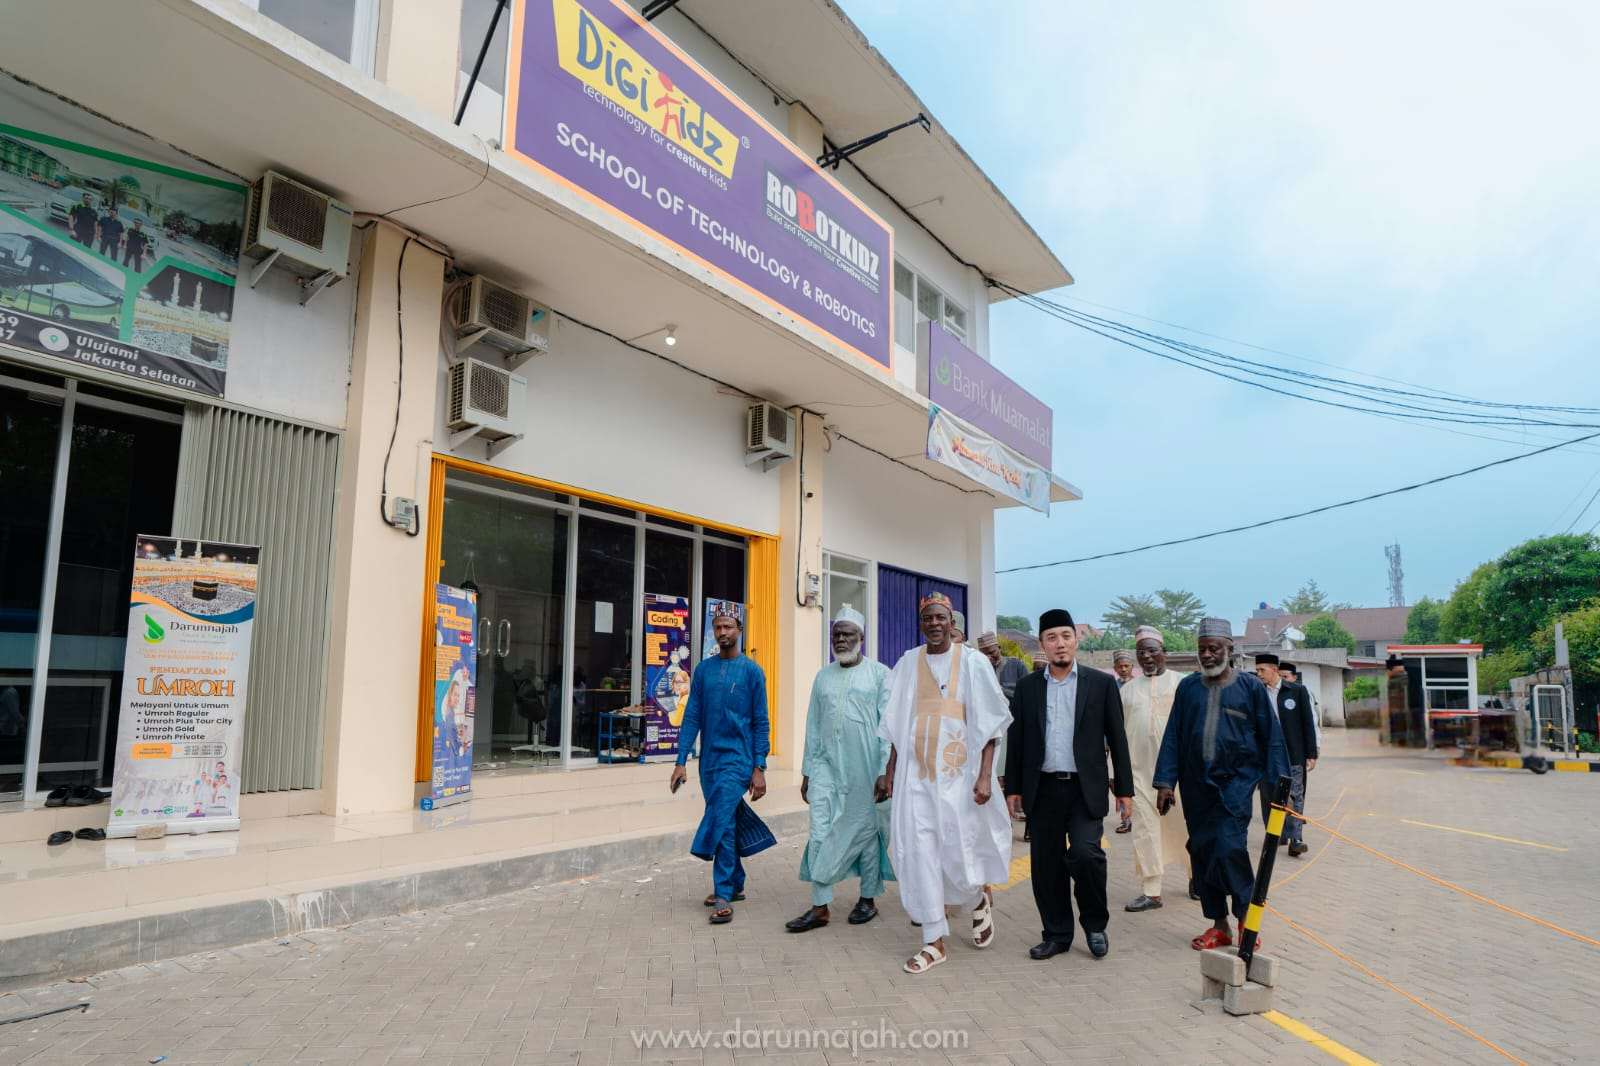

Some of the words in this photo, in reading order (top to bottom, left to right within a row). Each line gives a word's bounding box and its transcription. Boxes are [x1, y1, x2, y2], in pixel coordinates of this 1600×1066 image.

[583, 82, 648, 135] technology
[650, 128, 665, 146] for
[666, 142, 708, 177] creative
[709, 168, 728, 191] kids
[556, 122, 653, 199] SCHOOL
[656, 187, 684, 215] OF
[688, 204, 800, 290] TECHNOLOGY
[802, 280, 812, 299] &
[815, 287, 875, 337] ROBOTICS
[76, 335, 139, 360] Ulujami
[73, 349, 135, 373] Jakarta
[140, 365, 196, 389] Selatan
[951, 362, 989, 411] Bank
[990, 389, 1051, 449] Muamalat
[170, 621, 239, 634] Darunnajah
[651, 613, 678, 626] Coding
[136, 674, 236, 697] UMROH
[130, 701, 171, 710] Melayani
[216, 718, 232, 726] City
